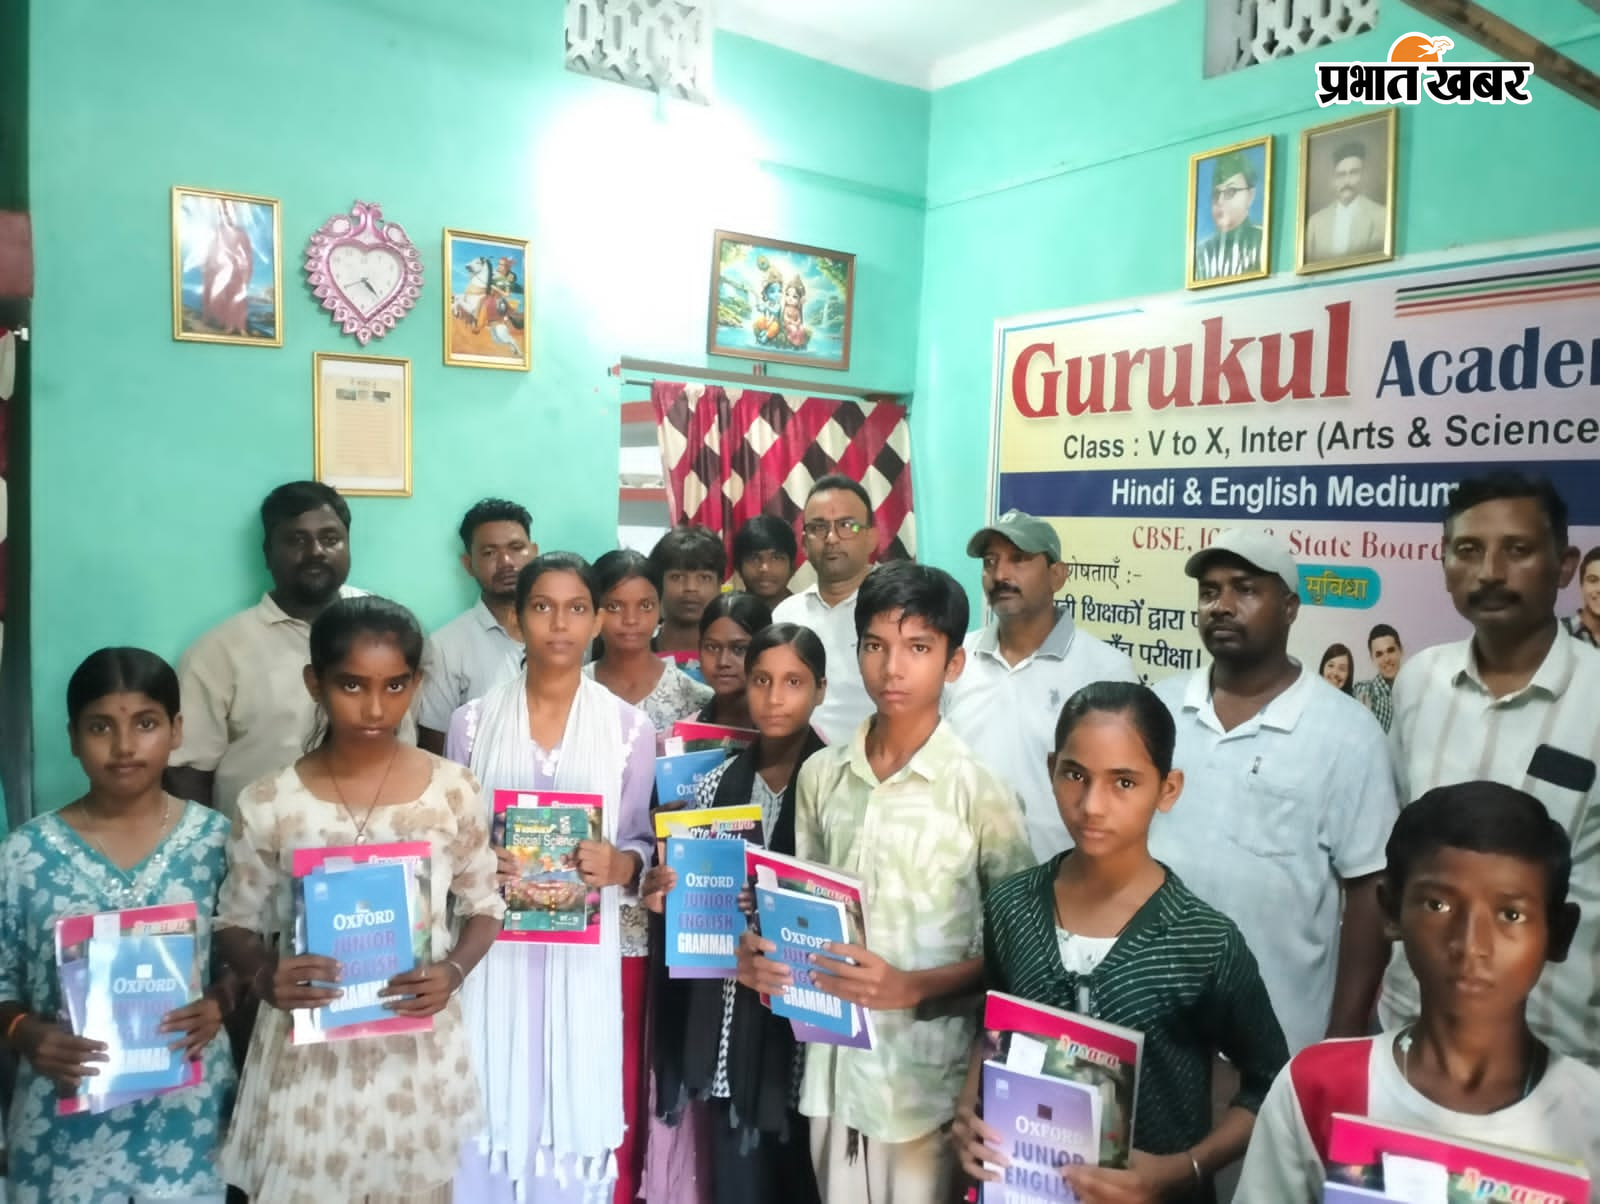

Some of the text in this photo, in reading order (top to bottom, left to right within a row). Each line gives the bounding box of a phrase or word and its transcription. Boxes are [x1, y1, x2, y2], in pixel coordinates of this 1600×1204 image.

[1011, 301, 1600, 419] Gurukul Acade
[1063, 434, 1125, 460] Class
[1148, 429, 1166, 456] V
[1173, 434, 1198, 456] to
[1206, 426, 1231, 459] X,
[1241, 425, 1308, 455] Inter
[1317, 420, 1395, 459] (Arts
[1407, 416, 1432, 449] &
[1445, 413, 1600, 447] Science
[1111, 478, 1175, 508] Hindi
[1184, 477, 1203, 507] &
[1211, 476, 1318, 514] English
[1132, 525, 1193, 552] CBSE,
[1288, 528, 1351, 558] State
[1081, 594, 1146, 627] शिक्षकों
[1148, 606, 1185, 631] द्वारा
[685, 872, 734, 888] OXFORD
[333, 908, 396, 931] OXFORD
[677, 934, 734, 956] GRAMMAR
[112, 976, 178, 994] OXFORD
